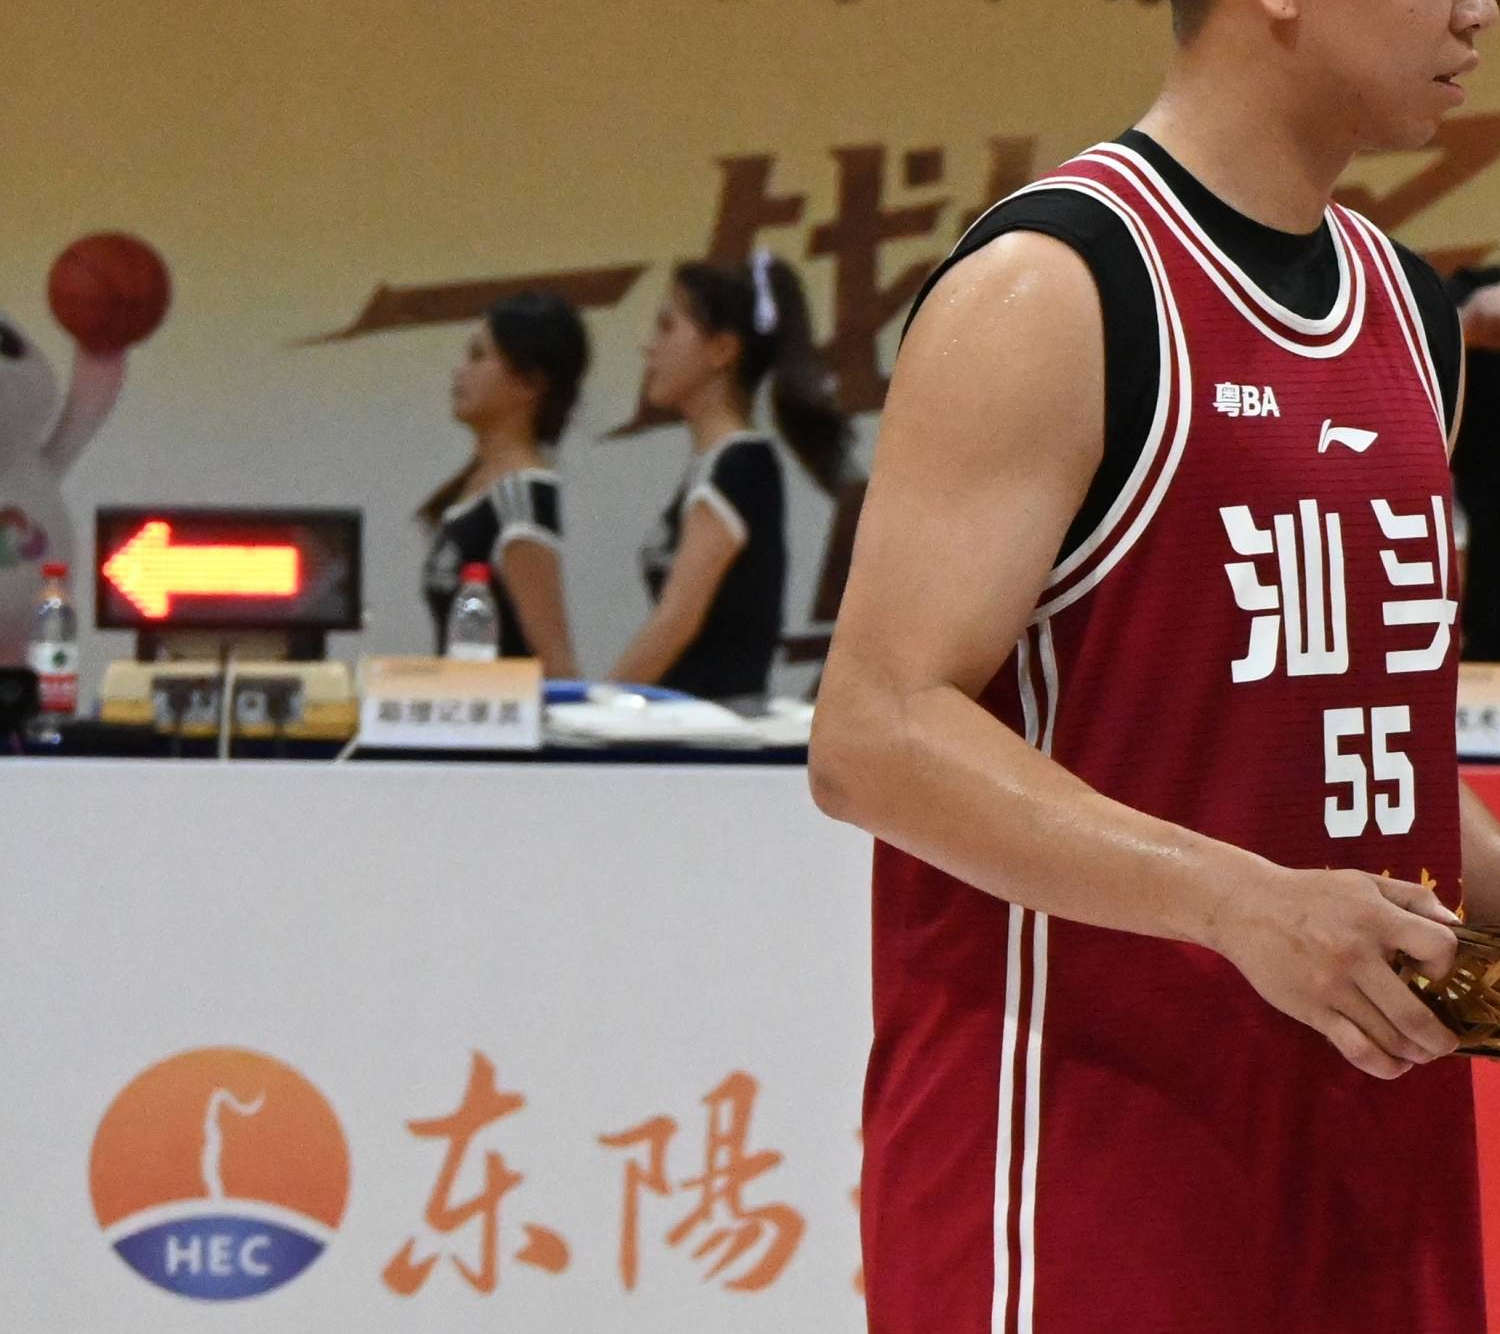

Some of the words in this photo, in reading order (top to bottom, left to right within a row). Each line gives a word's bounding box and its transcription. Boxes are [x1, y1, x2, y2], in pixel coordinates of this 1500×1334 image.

[1212, 381, 1280, 419] 粤BA
[1219, 495, 1458, 683] 汕头
[1322, 705, 1416, 839] 55
[165, 1233, 272, 1276] HEC
